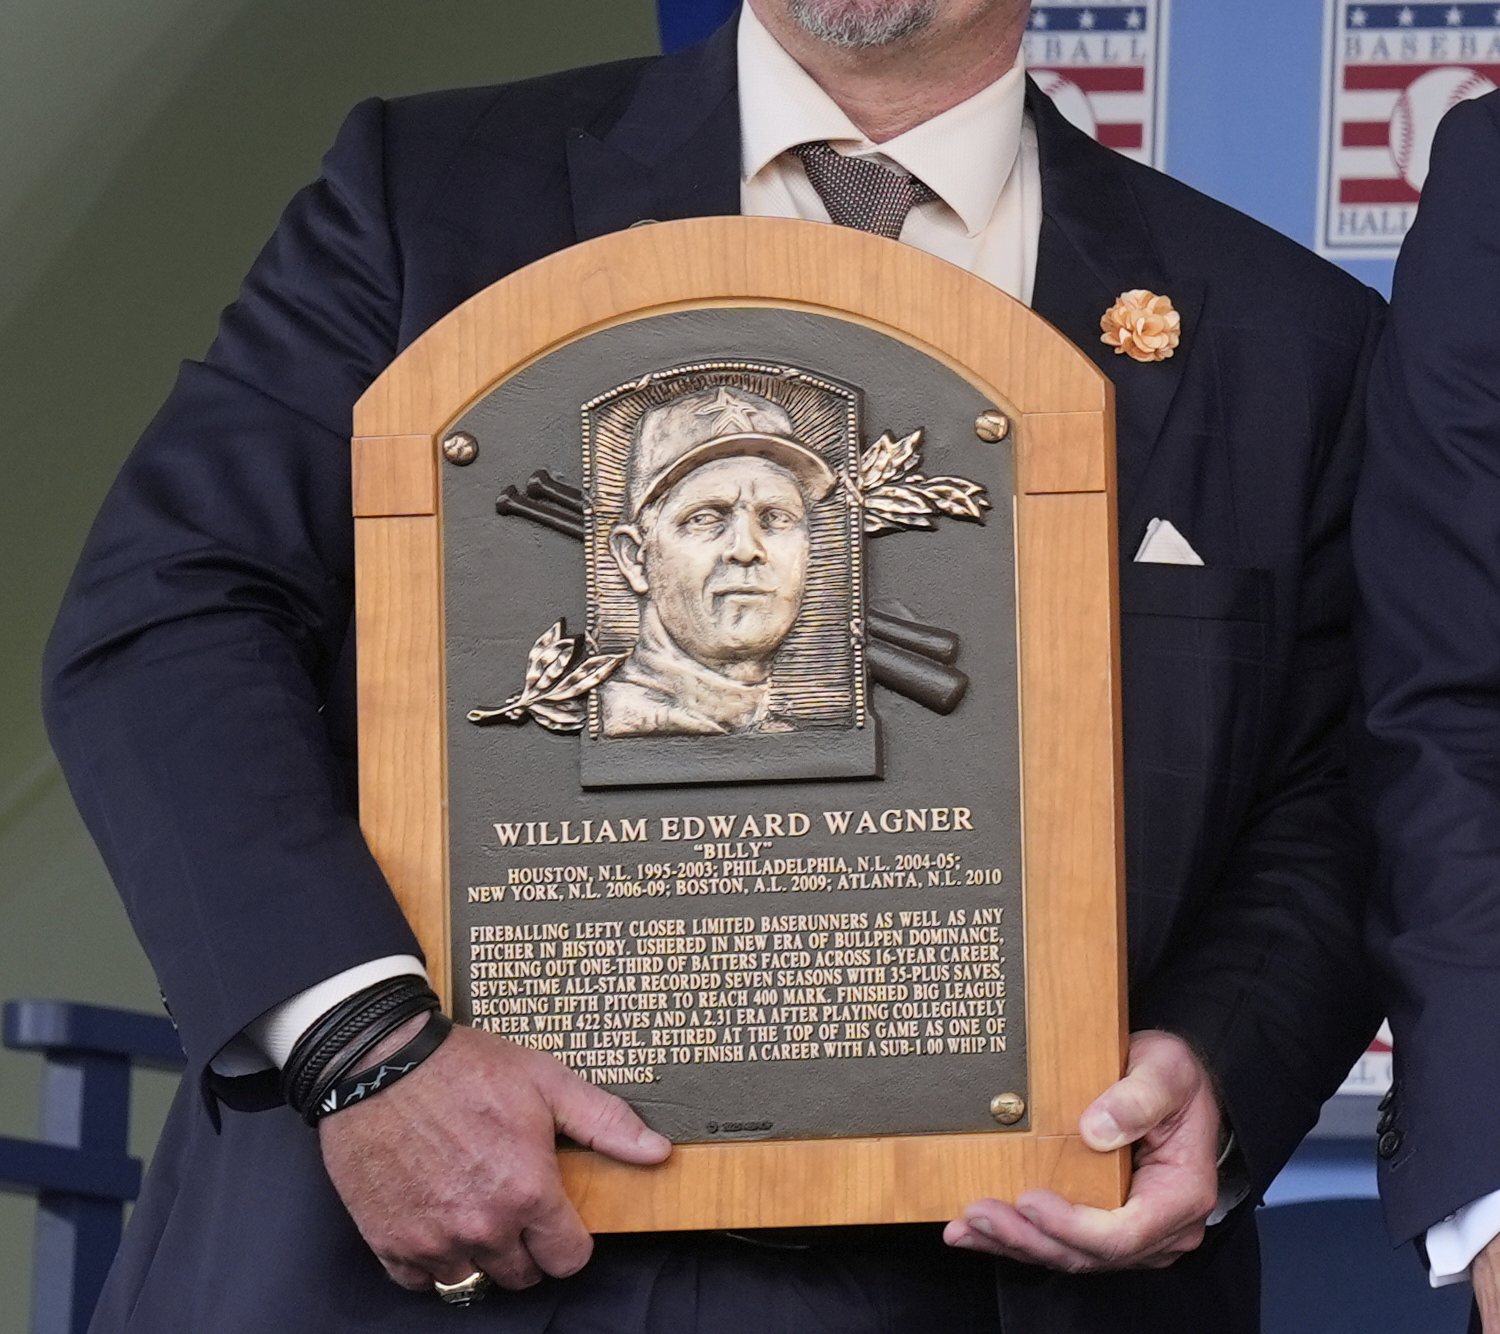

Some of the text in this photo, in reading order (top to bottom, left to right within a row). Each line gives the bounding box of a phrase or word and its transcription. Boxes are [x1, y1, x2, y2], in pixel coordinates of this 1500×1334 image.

[493, 807, 974, 846] WILLIAM EDWARD WAGNER
[467, 885, 507, 903] NEW
[567, 881, 602, 900] N.L.
[605, 879, 671, 898] 2006-09;
[675, 877, 749, 895] BOSTON,
[753, 875, 787, 893] A.L.
[790, 874, 832, 892] 2009;
[836, 871, 923, 890] ATLANTA,
[927, 870, 962, 887] N.L.
[964, 868, 1002, 886] 2010
[507, 854, 961, 885] HOUSTON, N.L. 1995-2003; PHILADELPHIA, N.L. 2004-05;
[470, 908, 1004, 943] FIREBALLING LEFTY CLOSER LIMITED BASERUNNERS AS WELL AS ANY
